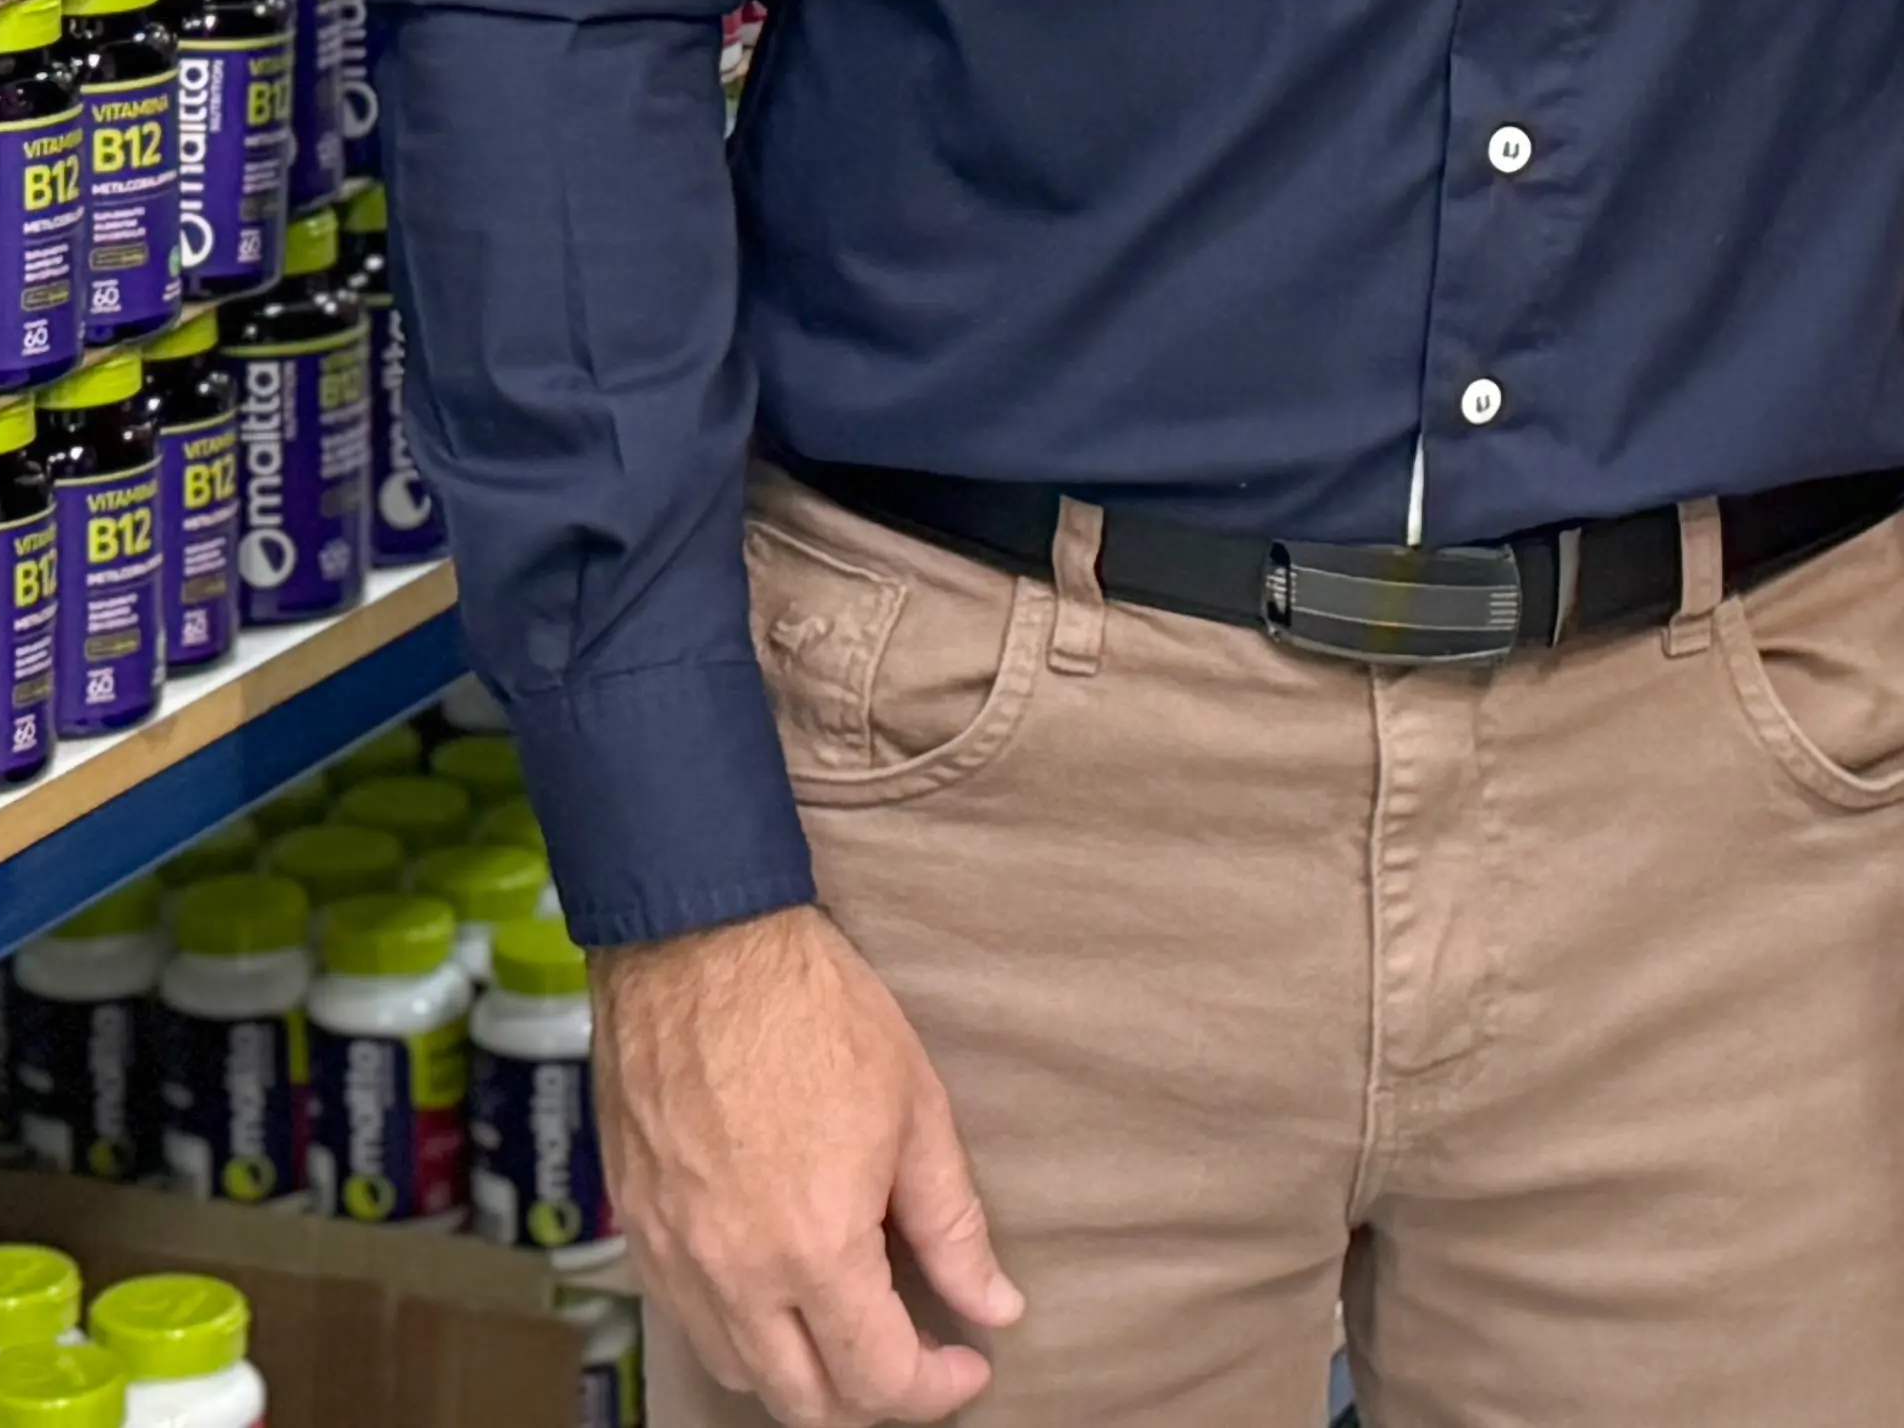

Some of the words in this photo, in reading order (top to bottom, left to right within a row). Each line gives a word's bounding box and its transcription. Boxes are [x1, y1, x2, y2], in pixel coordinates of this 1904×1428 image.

[91, 120, 162, 173] B12
[23, 154, 81, 212] B12
[183, 453, 236, 509] B12
[87, 507, 153, 564] B12
